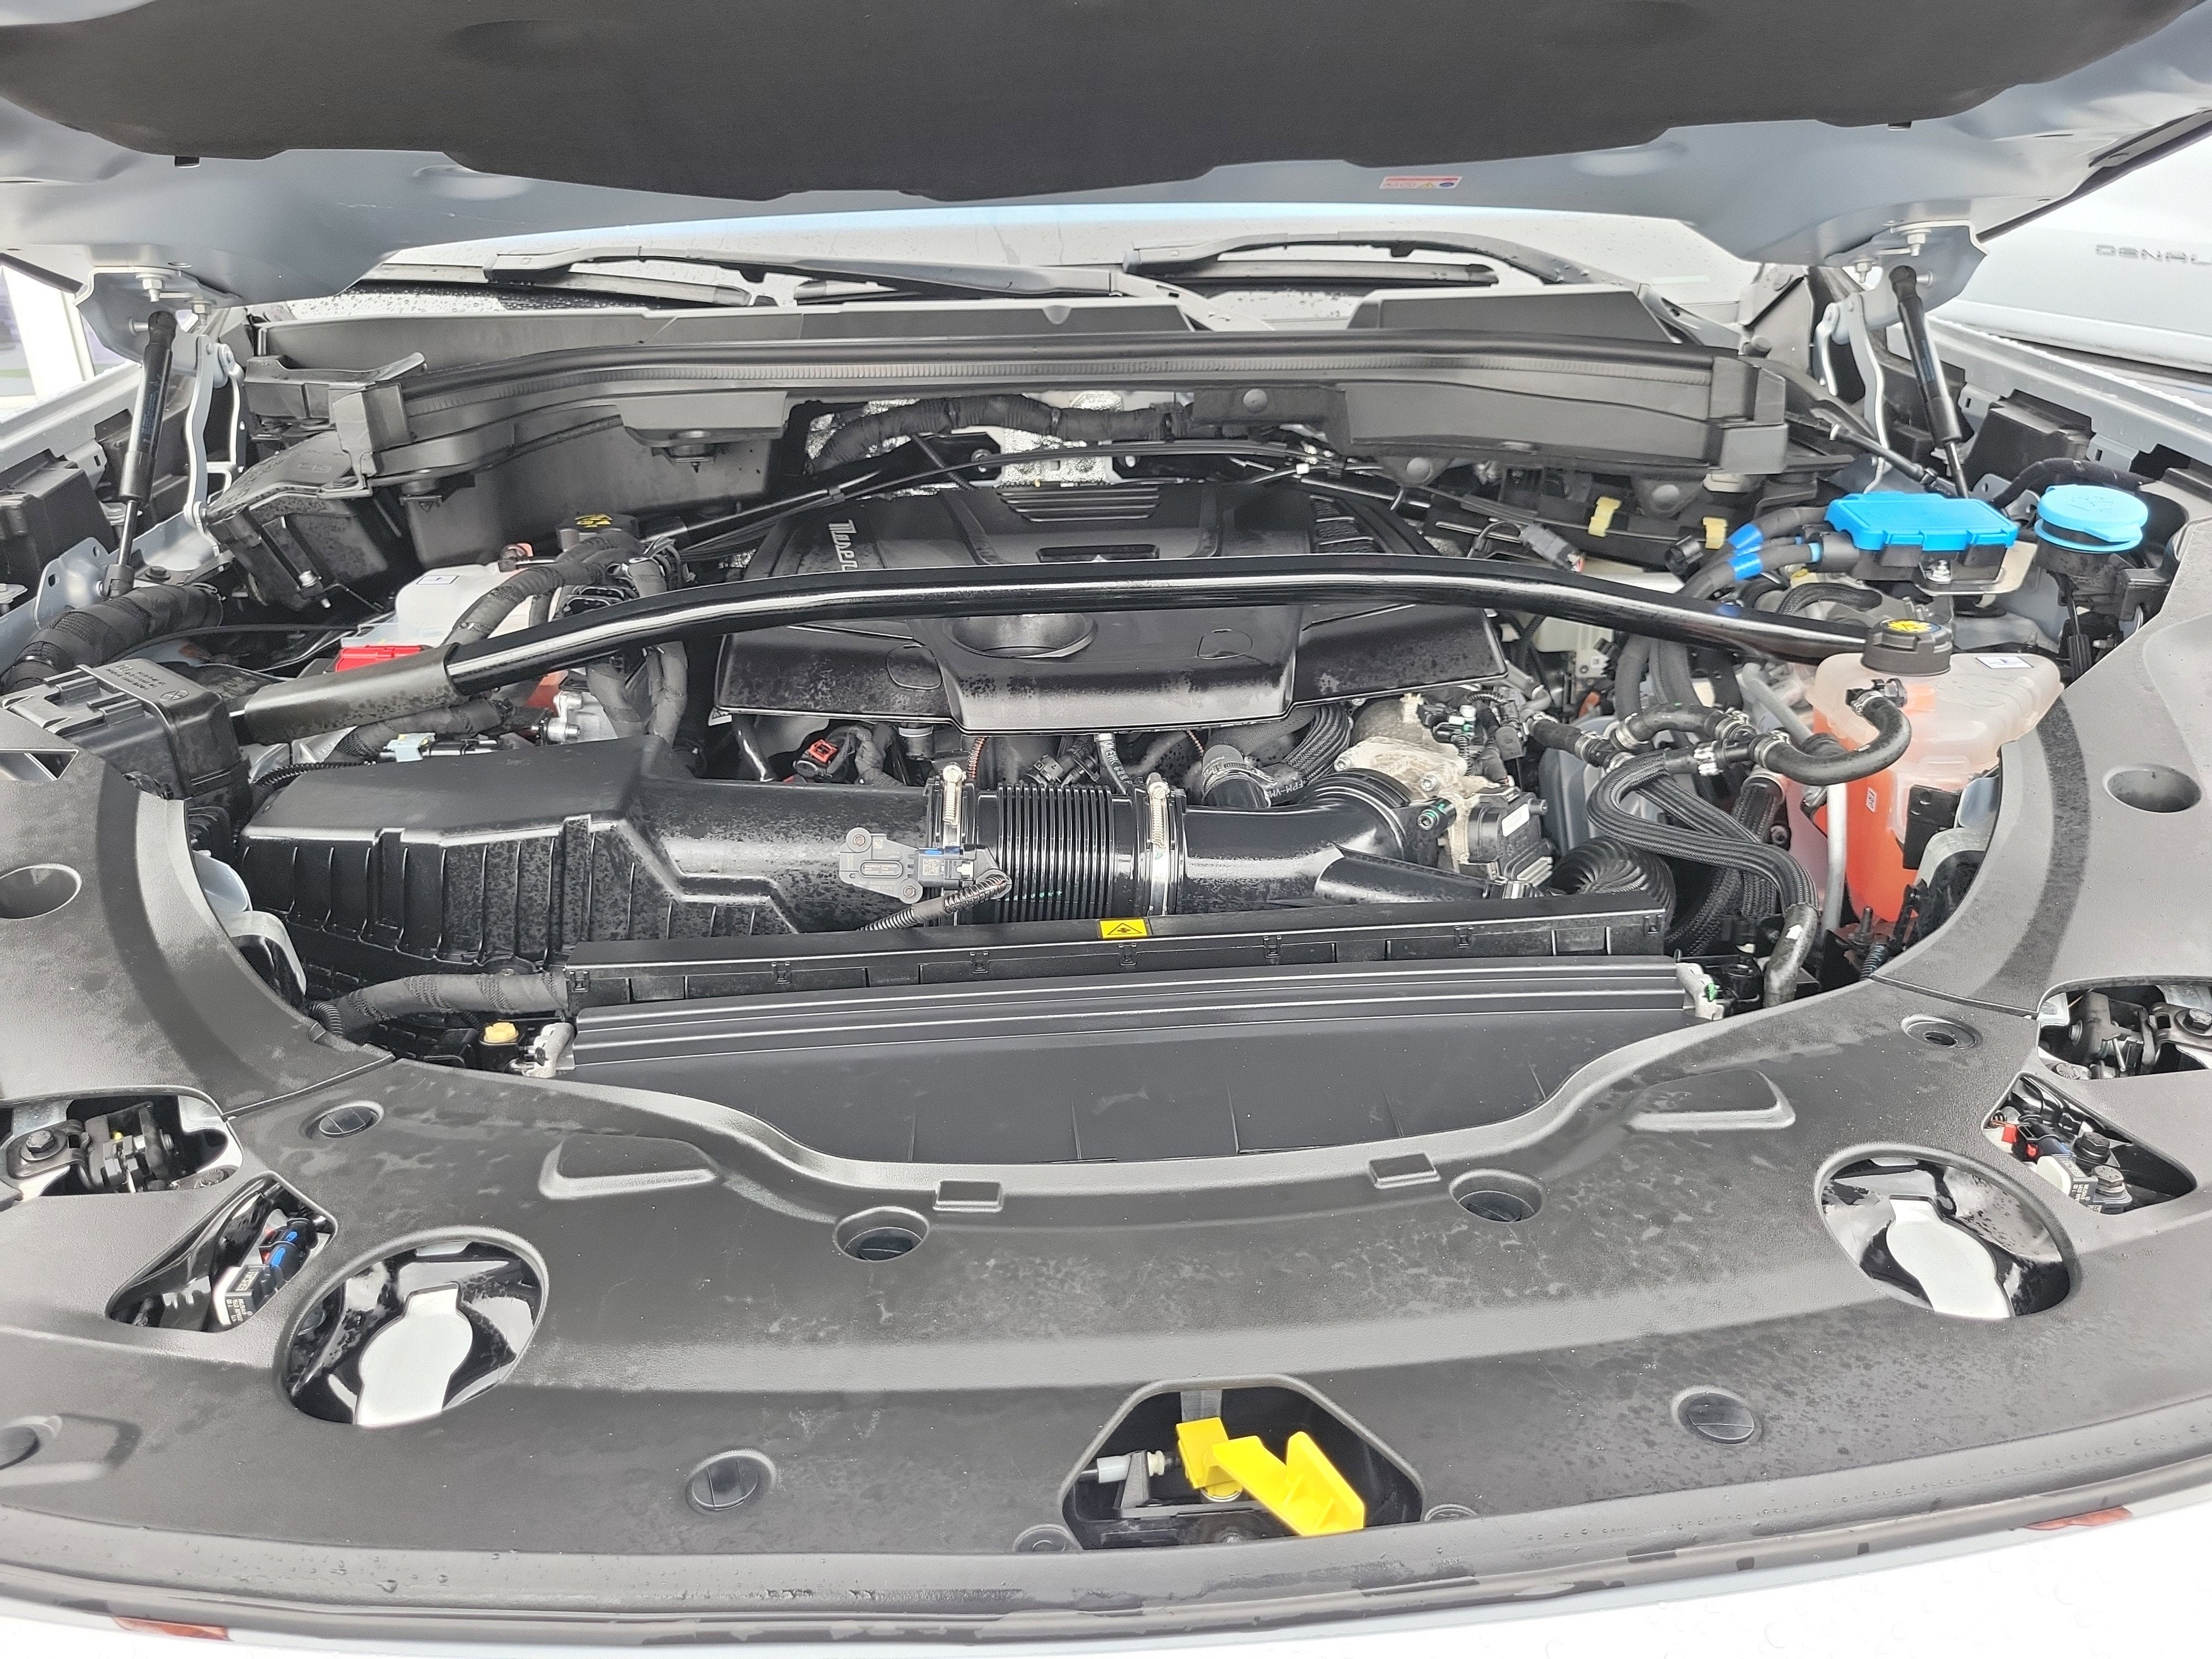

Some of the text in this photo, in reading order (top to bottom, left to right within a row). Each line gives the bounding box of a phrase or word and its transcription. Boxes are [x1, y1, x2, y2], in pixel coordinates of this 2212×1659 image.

[2095, 245, 2212, 266] DENAL
[828, 519, 859, 571] Maser
[1267, 779, 1304, 799] FPM-VM
